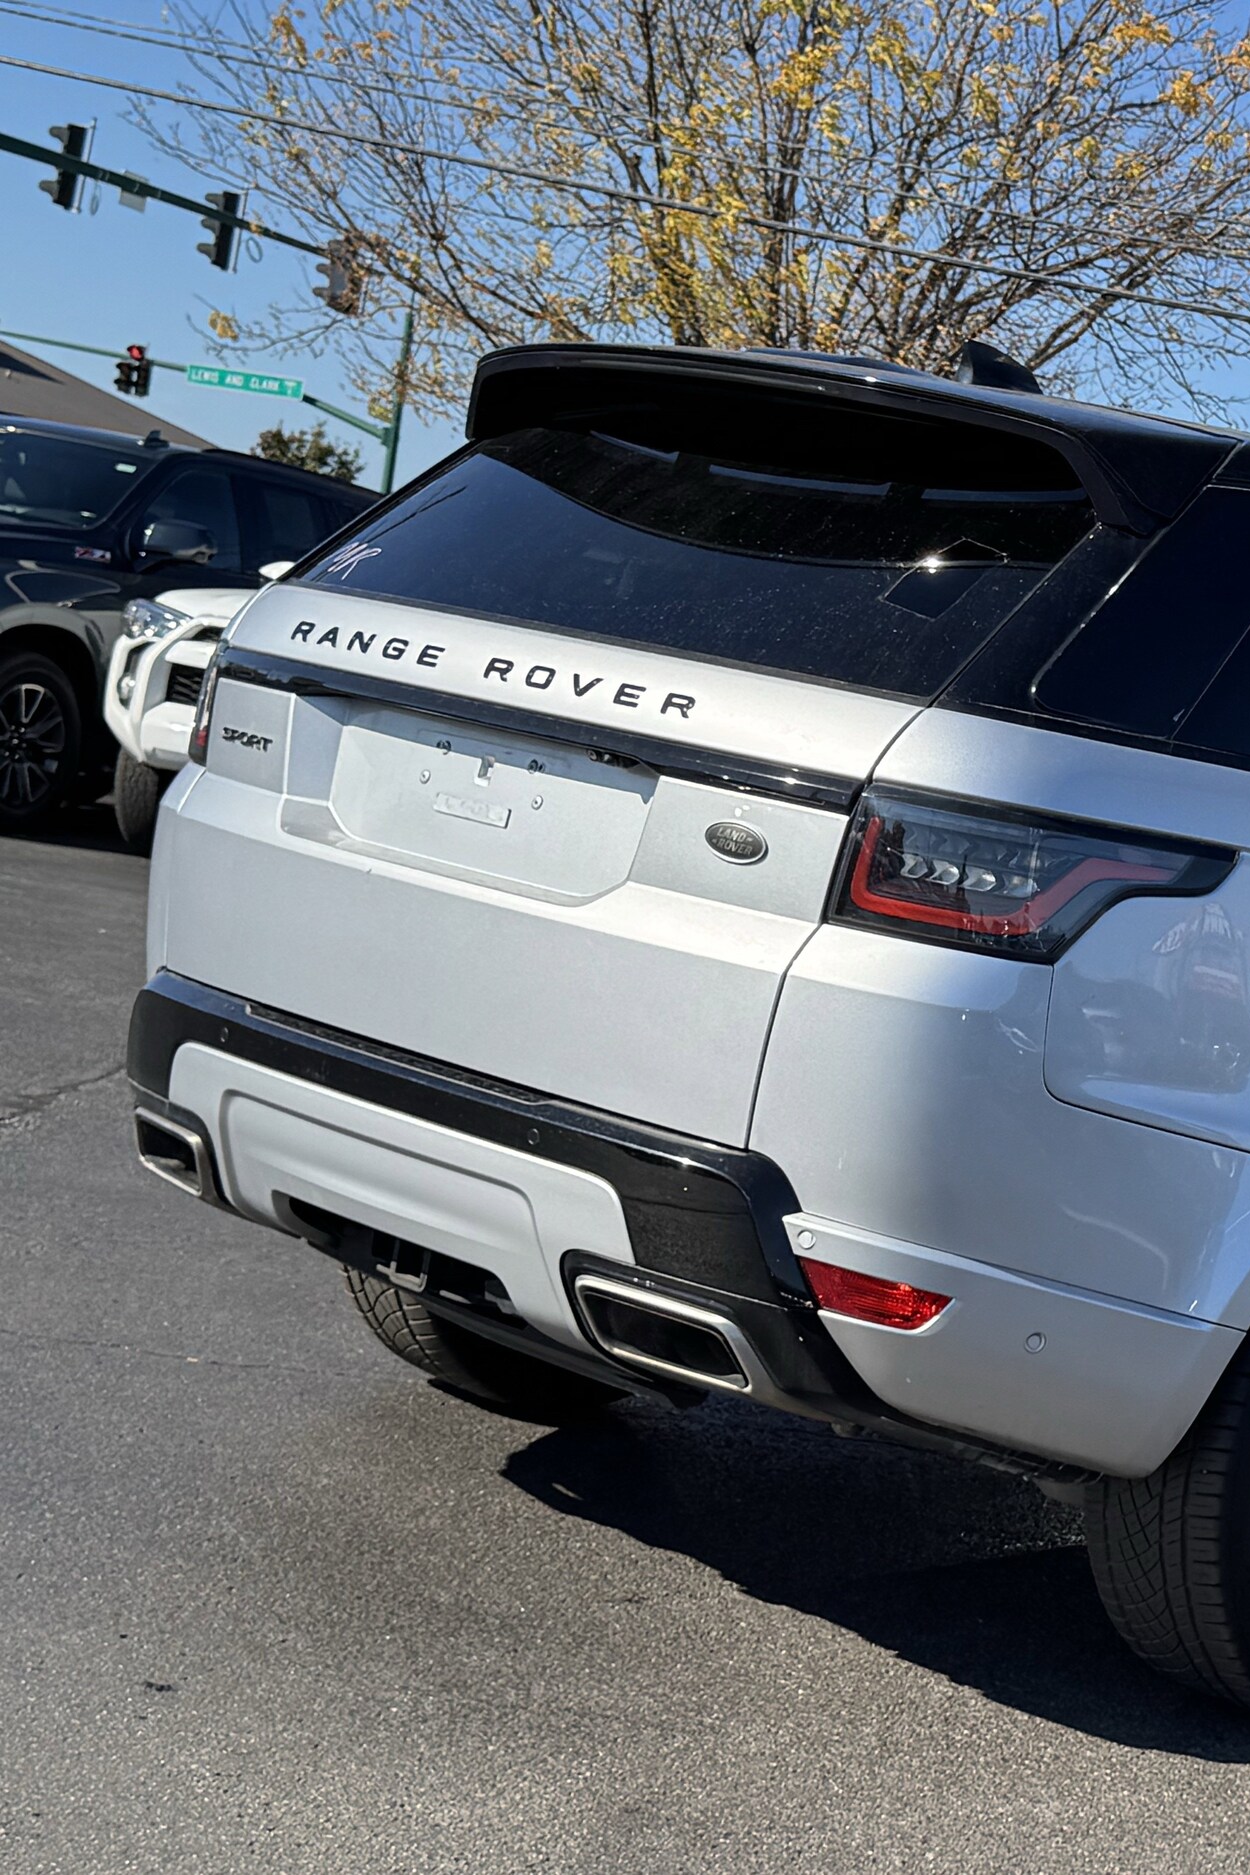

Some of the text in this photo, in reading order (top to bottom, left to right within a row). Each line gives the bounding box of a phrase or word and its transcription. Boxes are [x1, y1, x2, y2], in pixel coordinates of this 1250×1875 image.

[224, 374, 245, 387] AND
[248, 377, 281, 391] CLARK
[290, 620, 697, 719] RANGE ROVER
[222, 726, 273, 752] SPORT
[717, 827, 747, 842] LAND
[716, 839, 753, 855] ROVER
